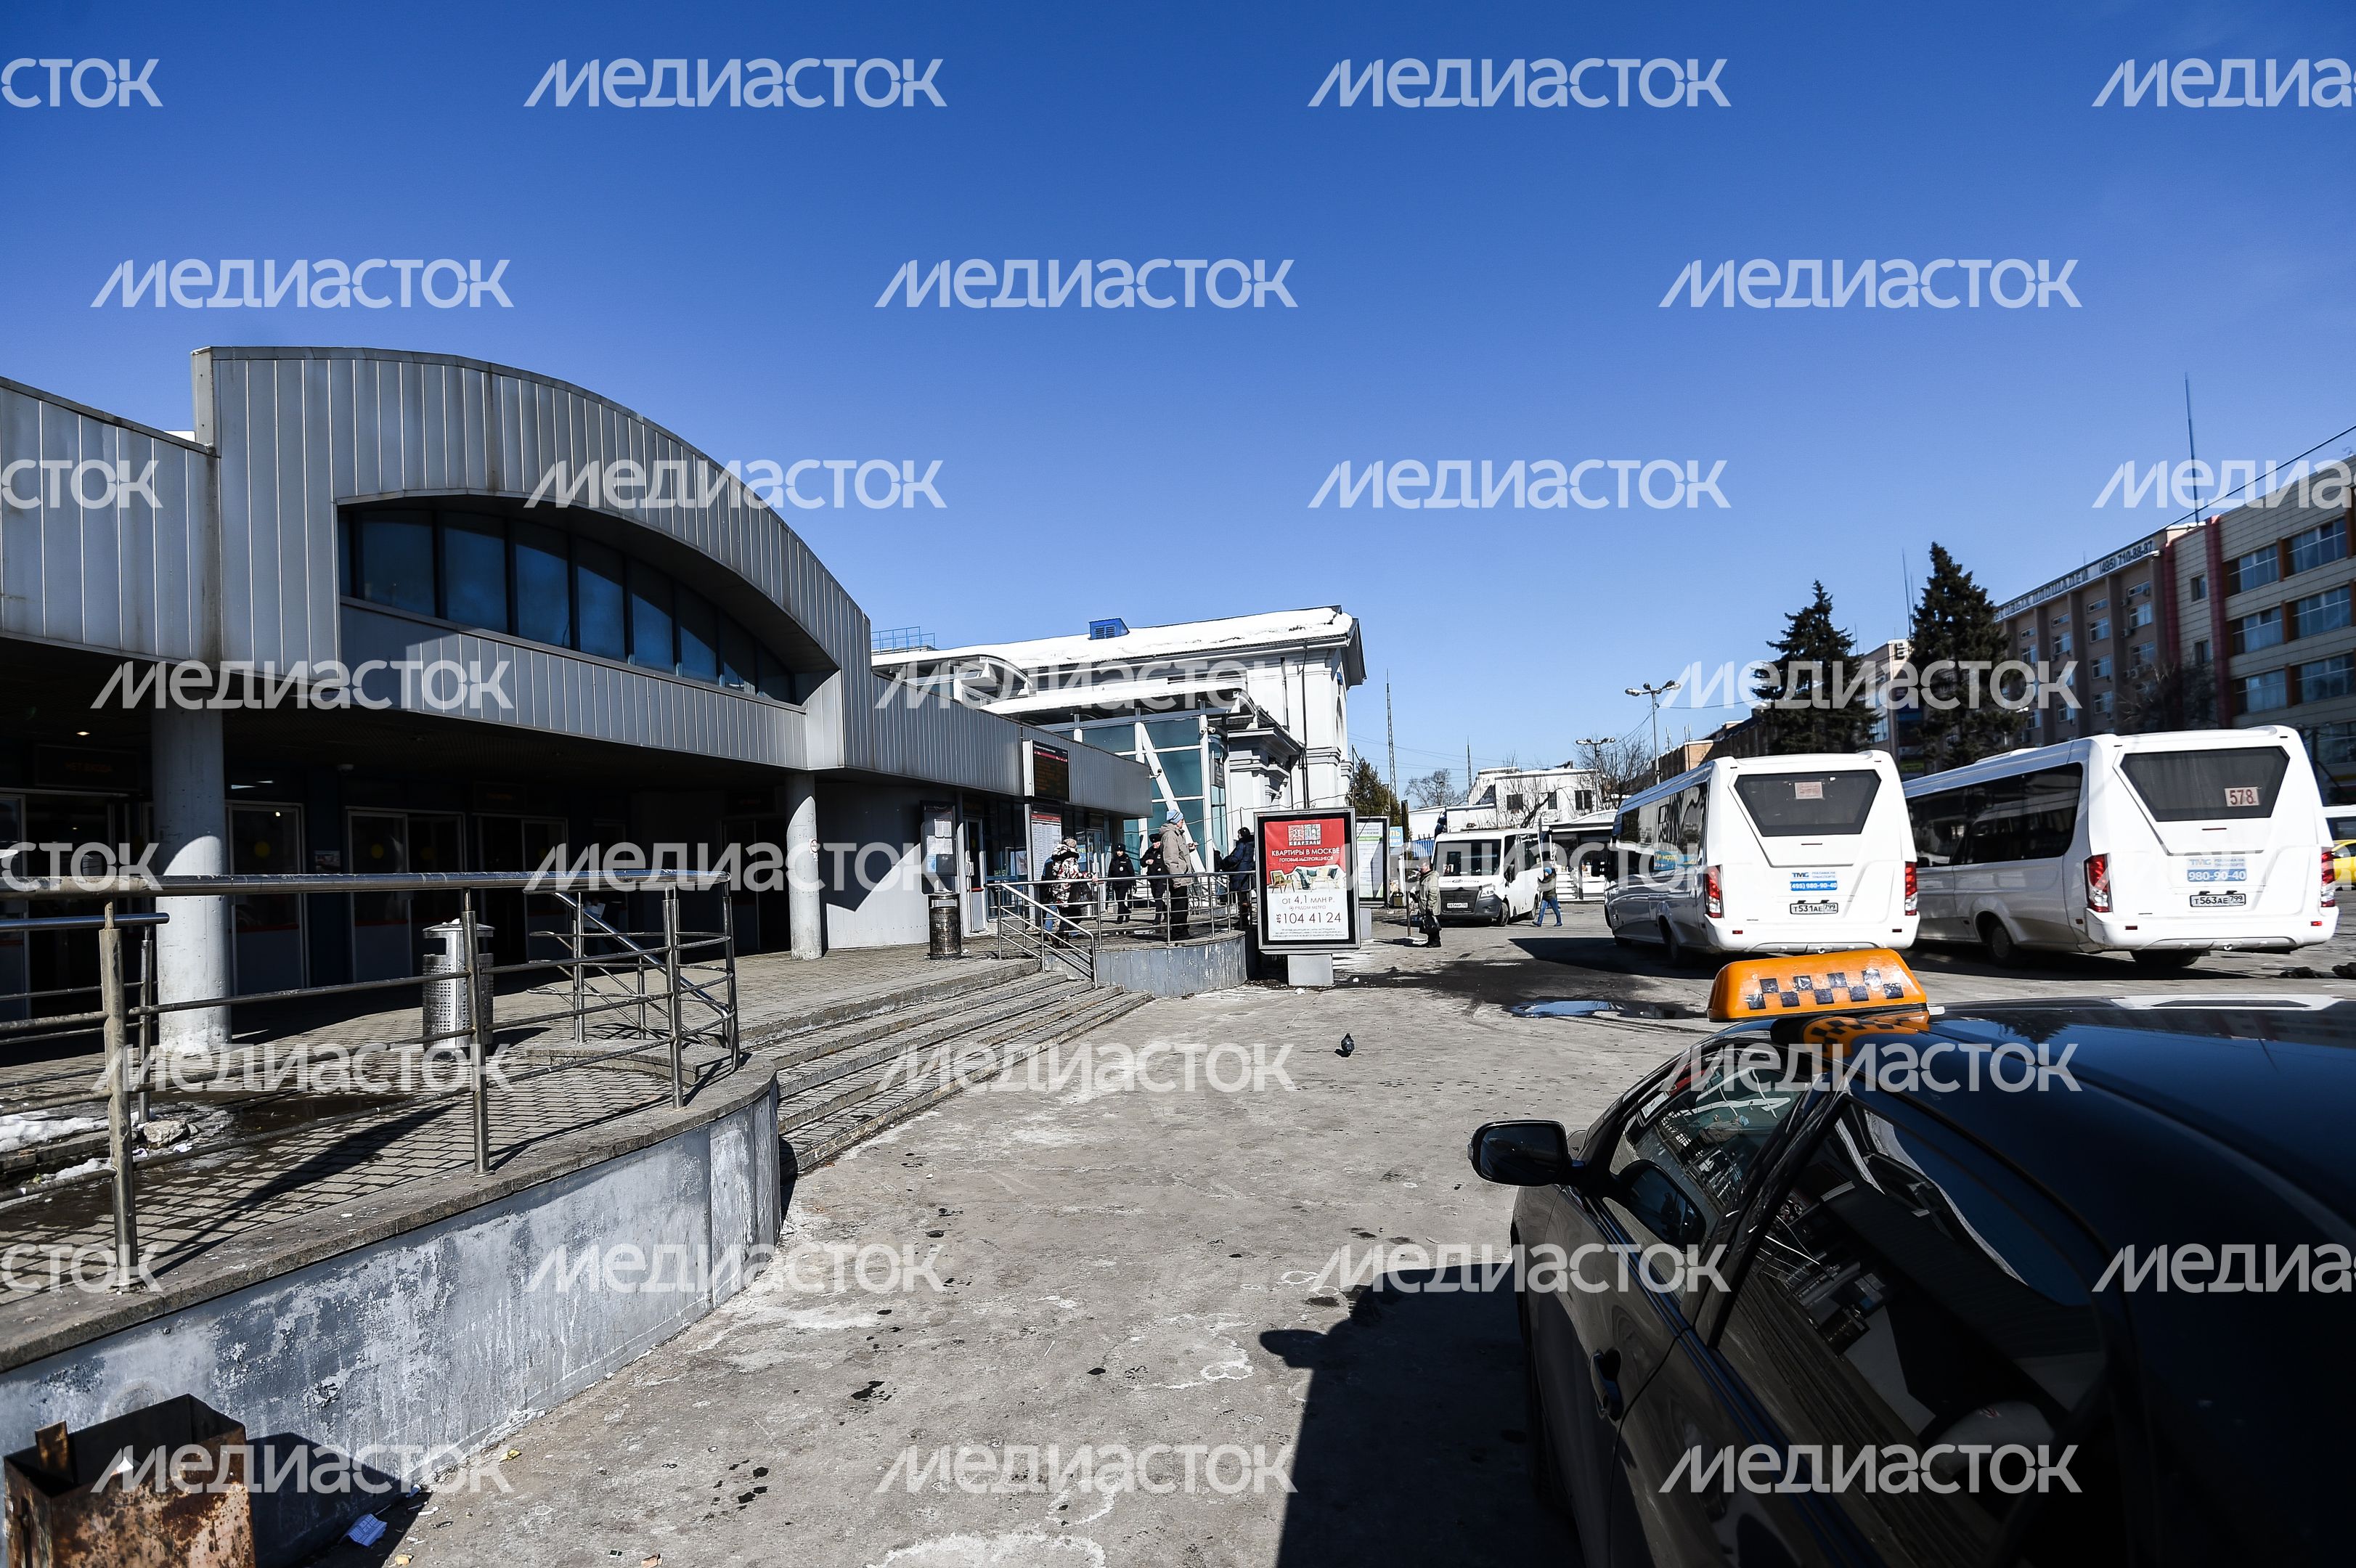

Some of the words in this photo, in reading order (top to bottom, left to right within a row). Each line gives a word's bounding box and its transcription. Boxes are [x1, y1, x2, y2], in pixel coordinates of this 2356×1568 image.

[2230, 789, 2254, 805] 578
[2188, 871, 2246, 881] 980-90-40
[1294, 895, 1308, 905] 4,1
[1284, 912, 1305, 924] 104
[1309, 912, 1321, 923] 41
[1326, 912, 1342, 923] 24
